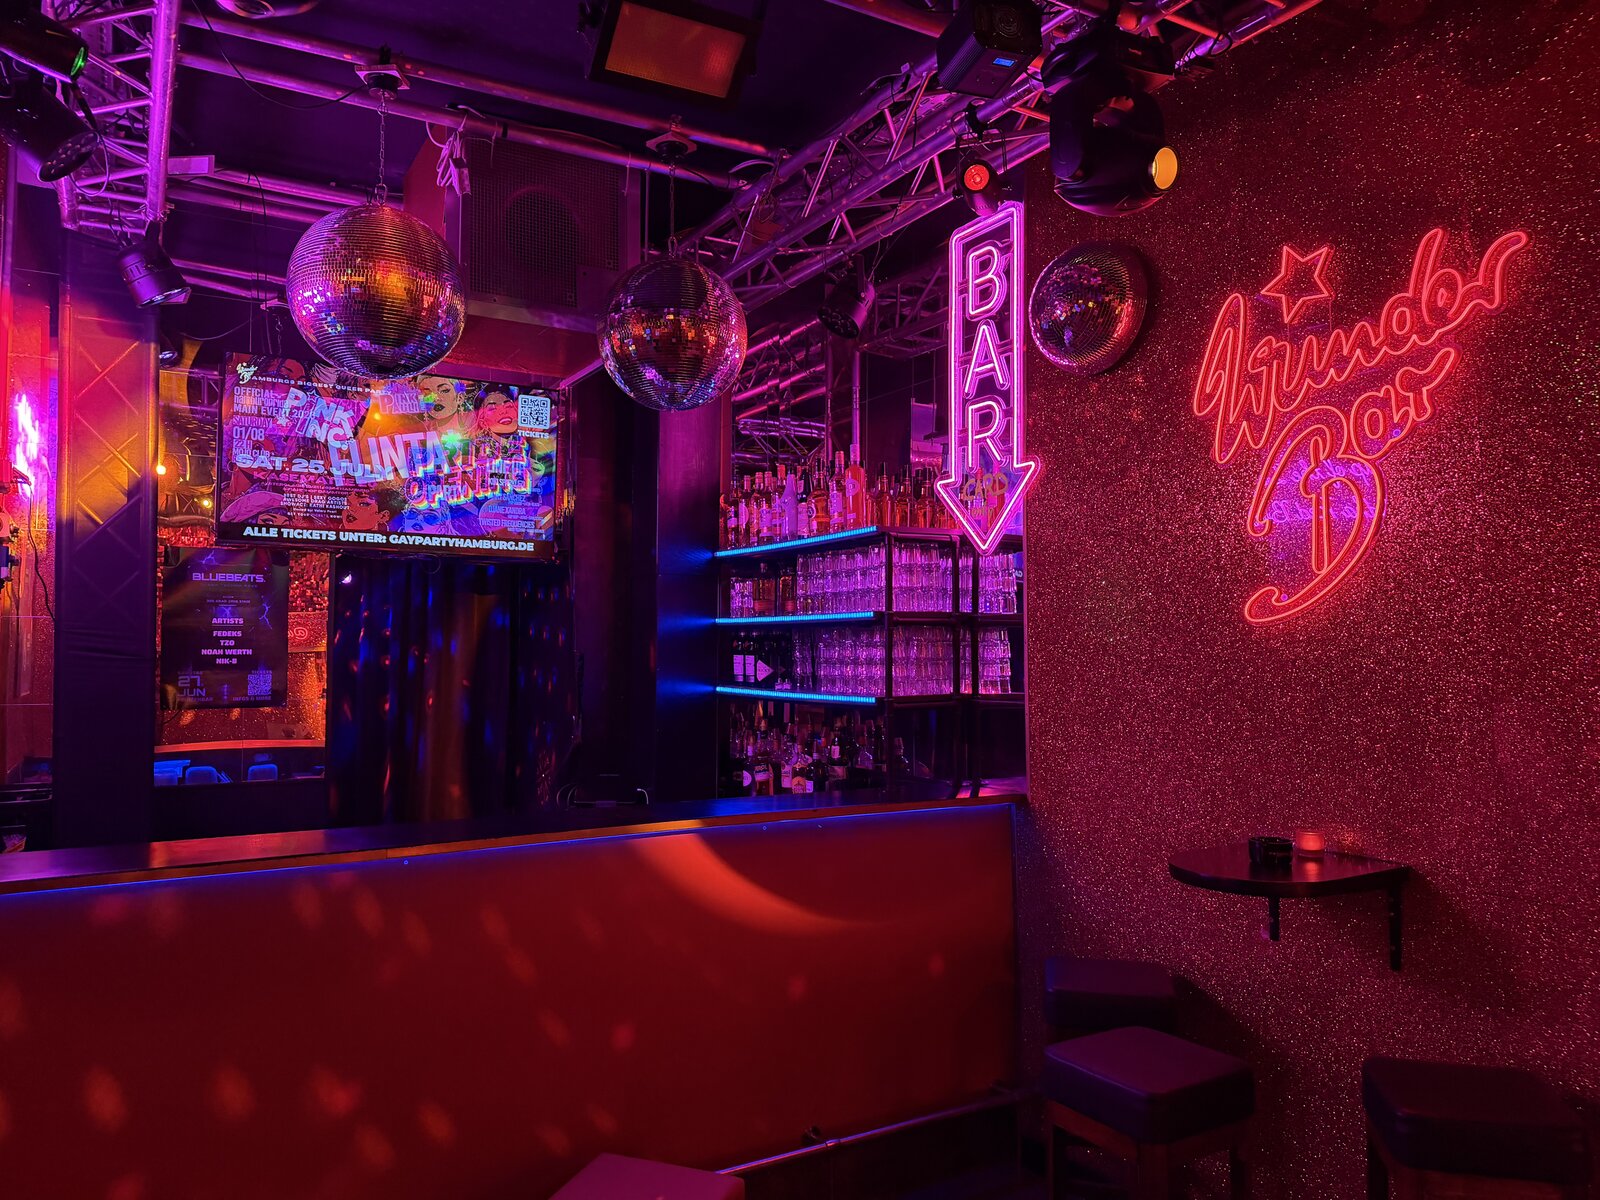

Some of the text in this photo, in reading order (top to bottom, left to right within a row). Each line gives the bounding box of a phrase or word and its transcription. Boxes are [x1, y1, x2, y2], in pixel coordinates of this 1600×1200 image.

[1193, 227, 1530, 464] Wunder
[964, 240, 1009, 473] BAR
[250, 375, 295, 385] AMBURGS
[233, 403, 258, 414] MAIN
[233, 426, 265, 441] 01/08
[236, 453, 289, 471] SAT.
[291, 458, 328, 474] 25.
[1244, 347, 1460, 622] Bar
[243, 526, 534, 551] ALLE TICKETS UNTER: GAYPARTYHAMBURG.DE
[212, 617, 244, 625] ARTISTS
